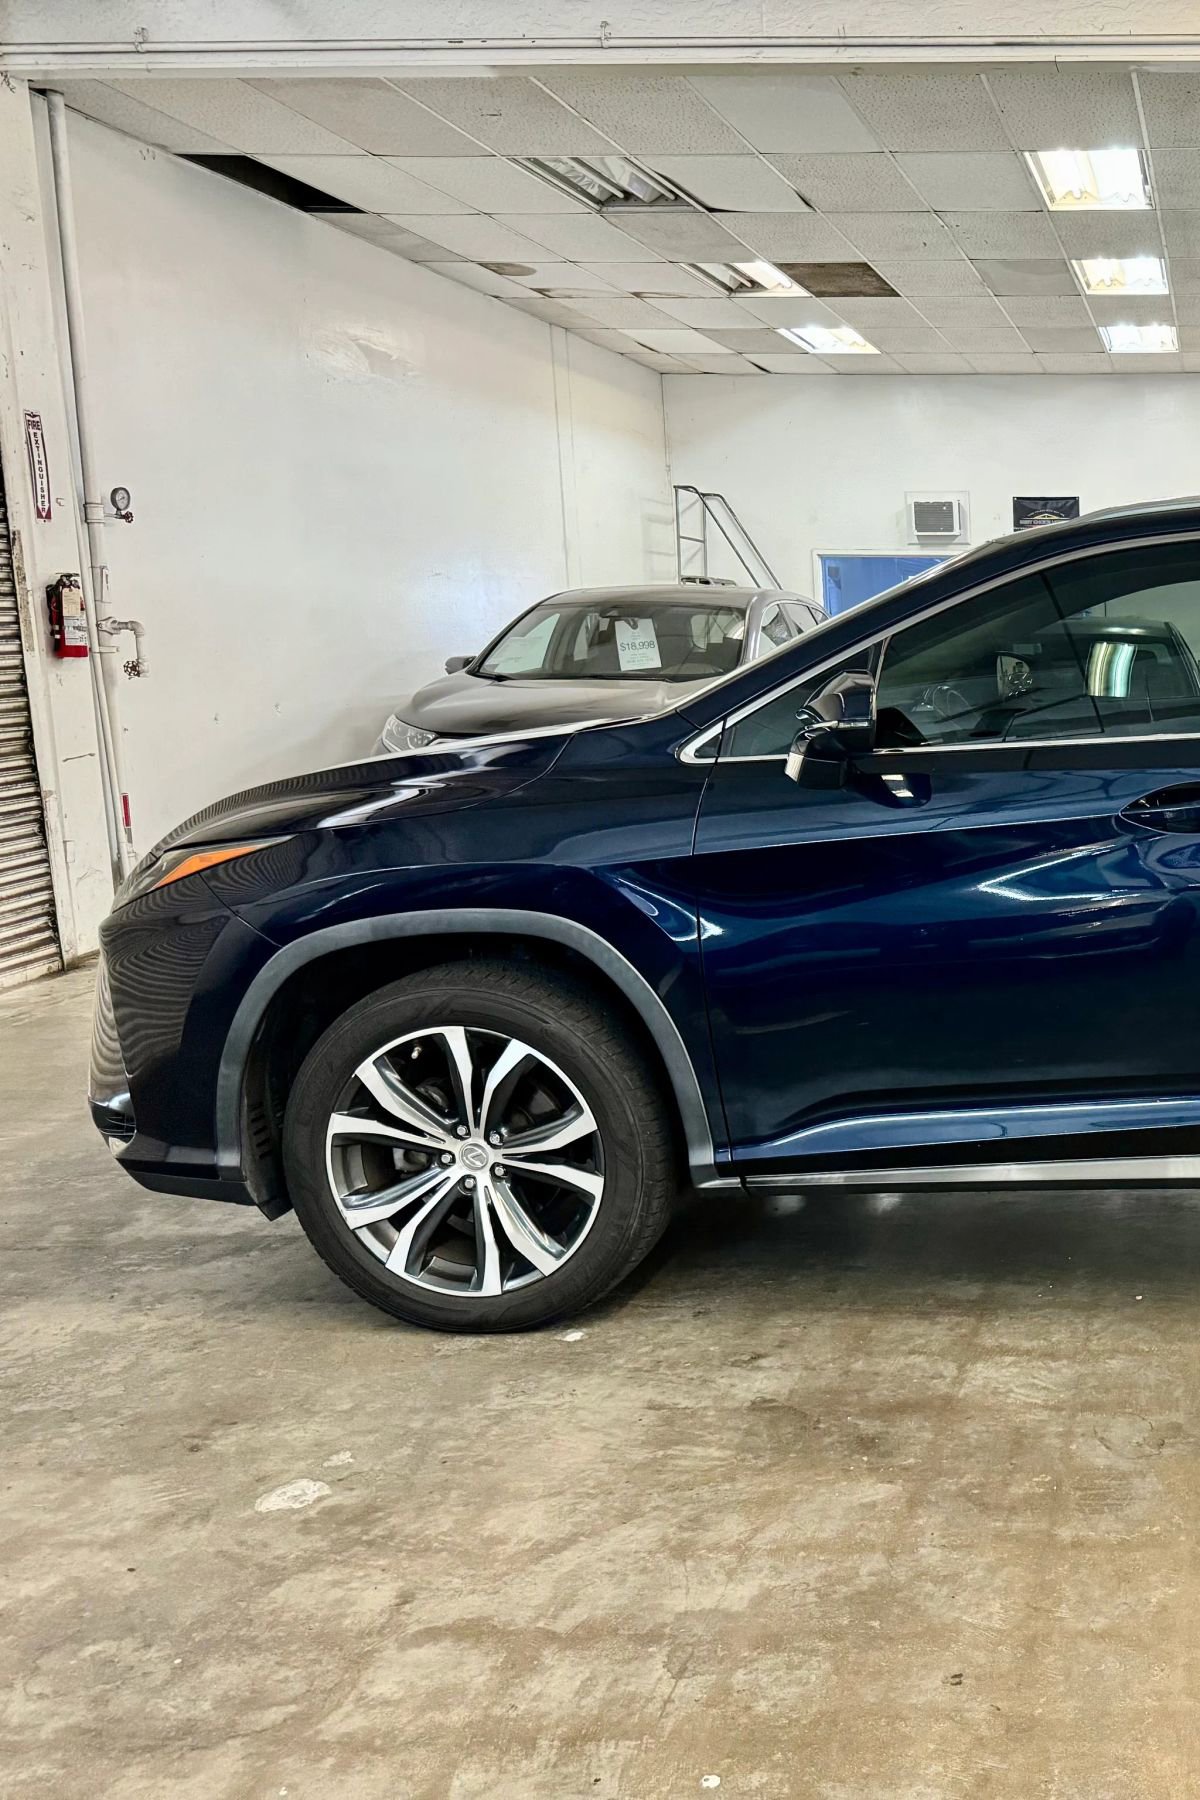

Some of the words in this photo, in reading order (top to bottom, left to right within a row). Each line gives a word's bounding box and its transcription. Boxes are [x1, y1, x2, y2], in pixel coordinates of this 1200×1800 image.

[27, 418, 41, 431] FIRE
[33, 431, 47, 514] EXTINGUISHER
[619, 640, 656, 652] $18,998
